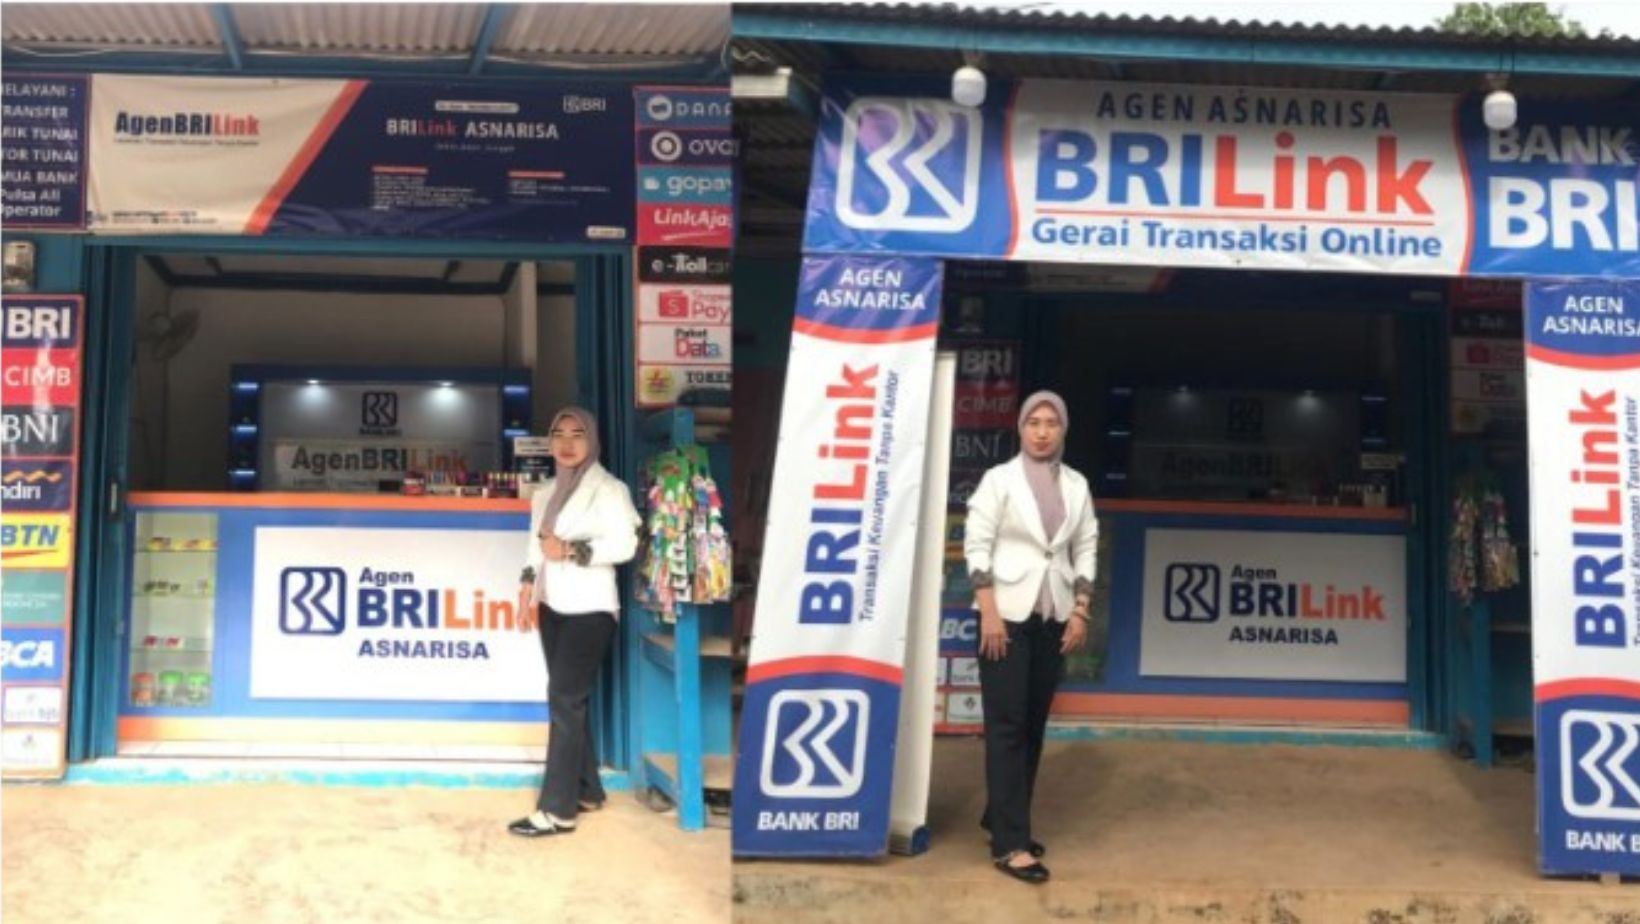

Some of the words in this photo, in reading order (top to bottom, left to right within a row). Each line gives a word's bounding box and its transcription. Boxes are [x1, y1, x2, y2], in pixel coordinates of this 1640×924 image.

[2, 82, 66, 97] ELAYANI
[2, 104, 69, 119] RANSFER
[1097, 91, 1194, 121] AGEN
[1207, 96, 1392, 128] ASNARISA
[2, 126, 27, 139] RIK
[31, 127, 78, 141] TUNAI
[115, 111, 260, 136] AgenBRILink
[386, 118, 458, 136] BRILink
[464, 121, 560, 140] ASNARISA
[32, 149, 78, 162] TUNAI
[1489, 124, 1636, 166] BANK
[37, 171, 78, 184] BANK
[1035, 128, 1434, 215] BRILink
[1488, 176, 1638, 252] BRI
[1032, 217, 1129, 247] Gerai
[1143, 221, 1307, 254] Transaksi
[1320, 227, 1442, 258] Online
[839, 268, 903, 288] AGEN
[814, 288, 926, 310] ASNARISA
[1563, 295, 1624, 314] AGEN
[7, 306, 71, 339] BRI
[675, 339, 720, 358] Data
[960, 349, 1013, 376] BRI
[5, 367, 71, 387] CIMB
[4, 413, 59, 443] BNI
[798, 363, 879, 624] BRILink
[858, 549, 879, 622] Transaksi
[880, 369, 898, 418] Kantor
[1568, 389, 1627, 648] BRILink
[1, 525, 59, 546] BTN
[359, 567, 414, 586] Agen
[1231, 564, 1277, 581] Agen
[357, 588, 538, 630] BRILin
[1229, 583, 1386, 620] BRILink
[1229, 626, 1338, 645] ASNARISA
[358, 640, 490, 659] ASNARISA
[757, 811, 820, 830] BANK
[824, 811, 861, 831] BRI
[1566, 830, 1627, 852] BANK
